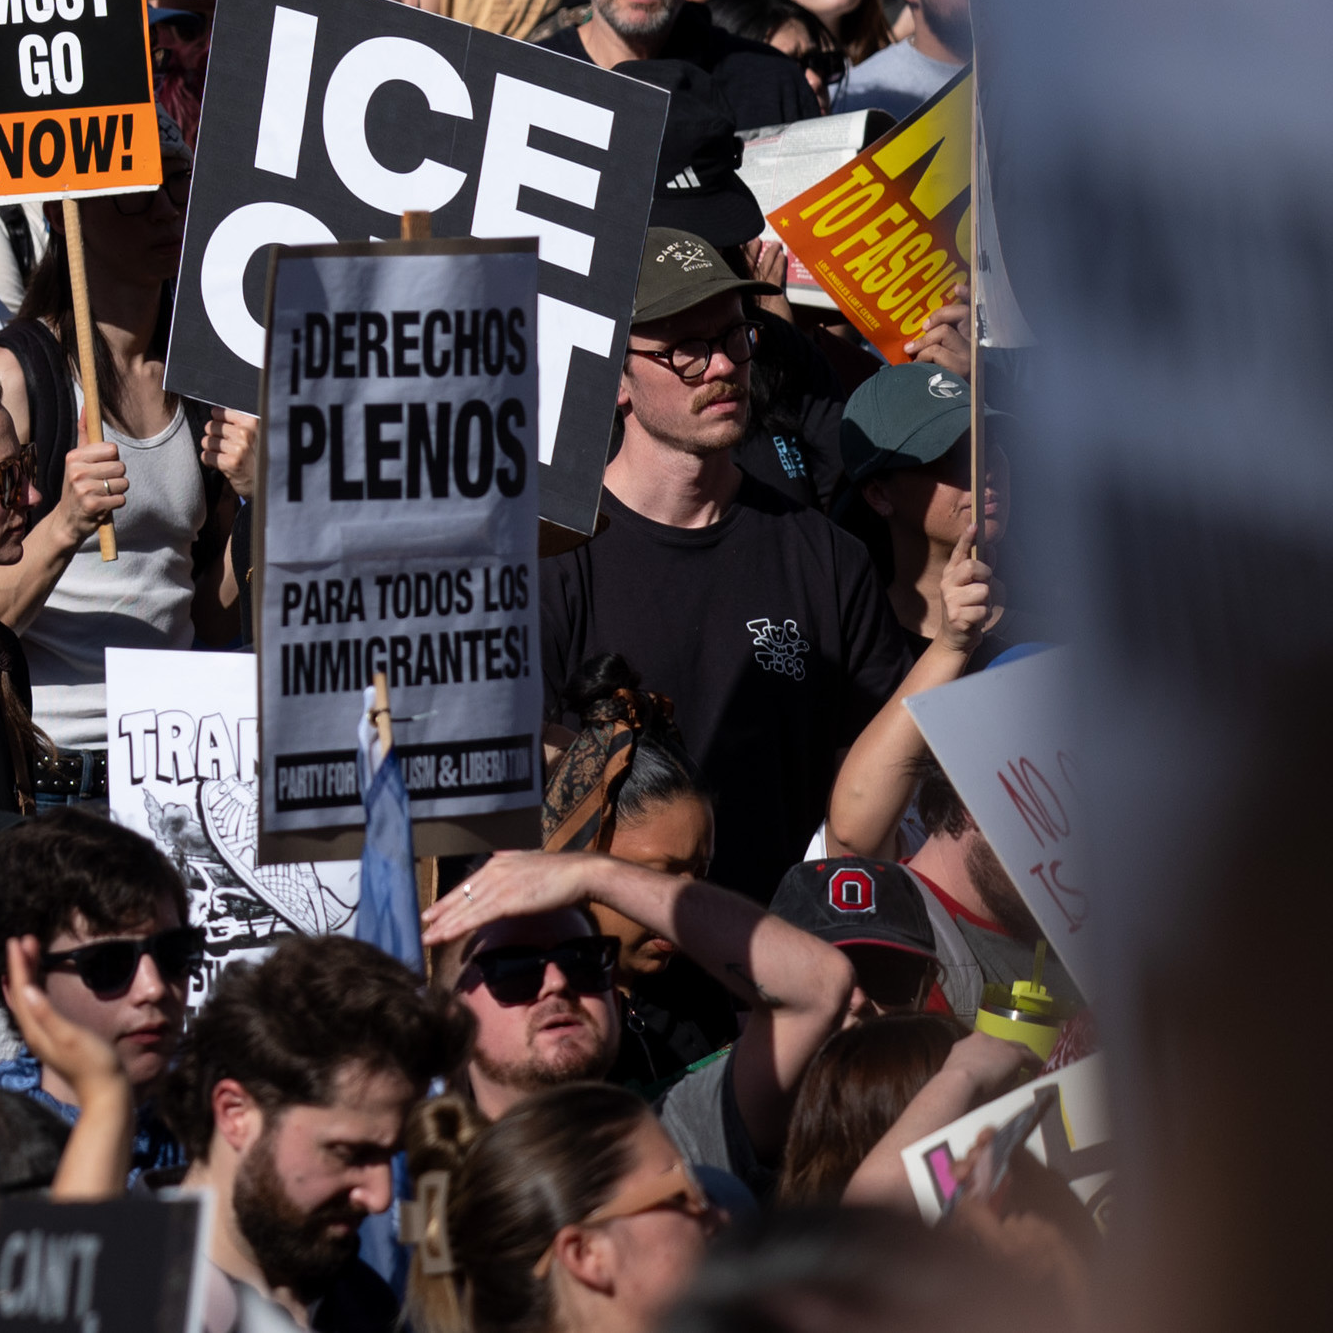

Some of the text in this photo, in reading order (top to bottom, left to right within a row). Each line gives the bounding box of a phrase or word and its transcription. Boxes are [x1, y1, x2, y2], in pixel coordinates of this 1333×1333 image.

[18, 32, 84, 98] GO
[253, 4, 616, 278] ICE
[798, 163, 886, 239] TO
[655, 240, 683, 264] DARK
[830, 201, 969, 342] FASCIS
[817, 259, 882, 331] LOS ANGELES LGBT CENTER
[200, 202, 618, 467] OT
[289, 307, 528, 396] ¡DERECHOS
[286, 398, 529, 504] PLENOS
[281, 565, 530, 628] PARA TODOS LOS
[281, 625, 531, 698] INMIGRANTES!
[278, 762, 326, 801] PARTY
[326, 760, 357, 797] FOR
[437, 753, 459, 789] &
[828, 867, 876, 913] O
